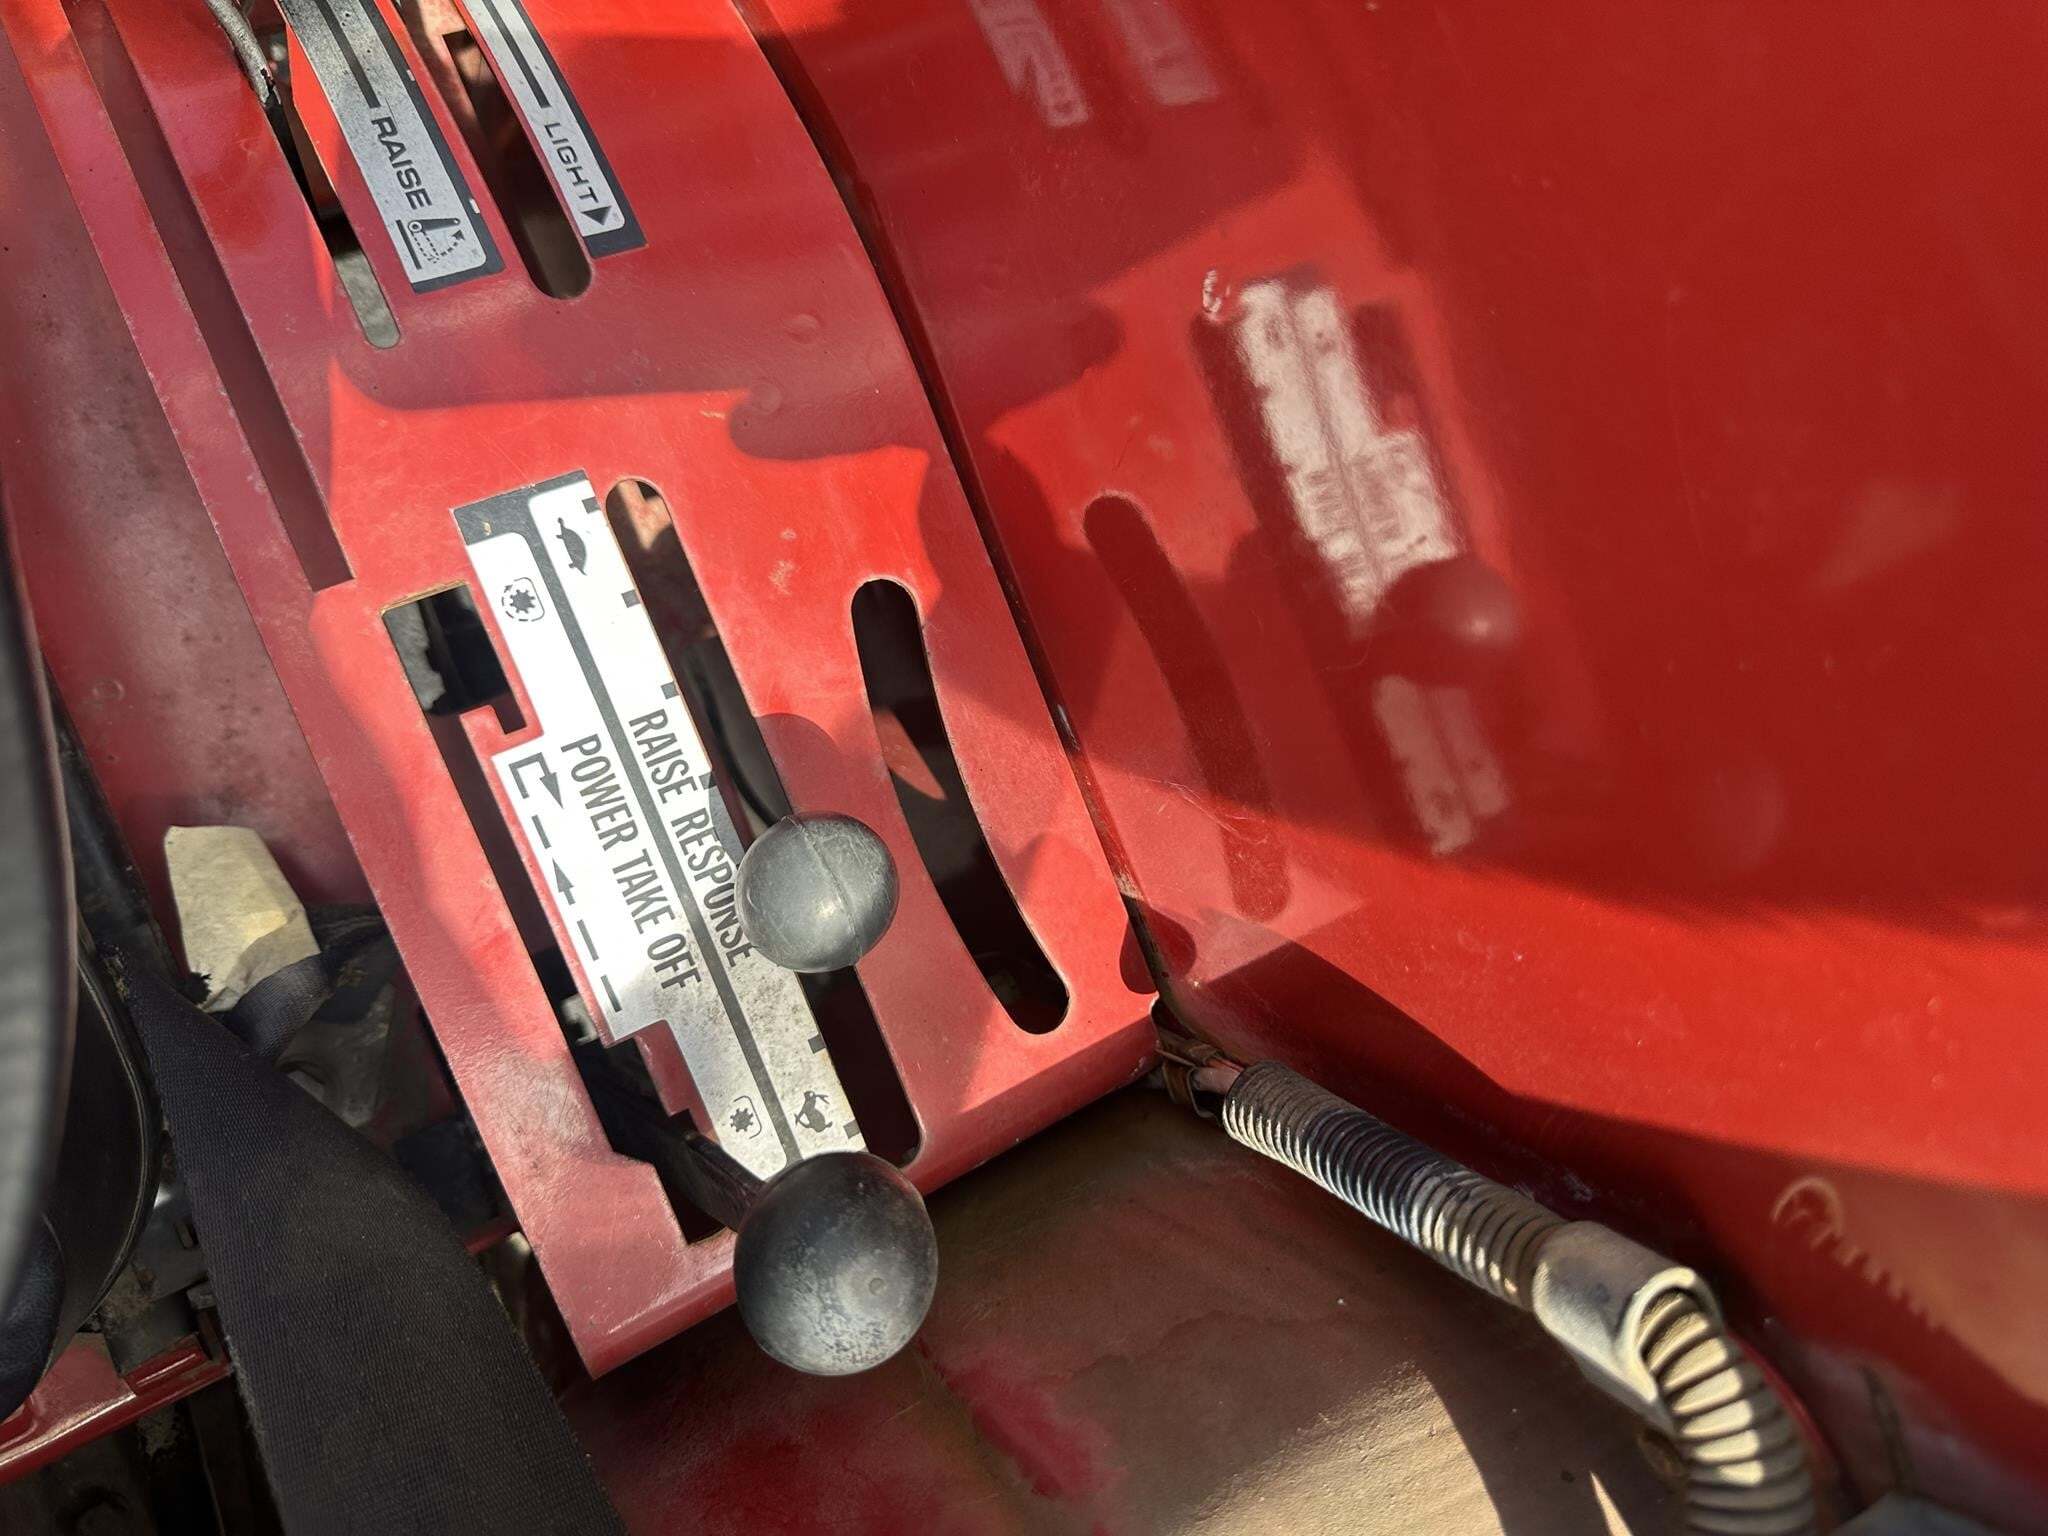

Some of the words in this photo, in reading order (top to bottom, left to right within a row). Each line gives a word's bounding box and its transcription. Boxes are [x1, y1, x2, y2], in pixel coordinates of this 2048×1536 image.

[371, 117, 432, 210] RAISE
[544, 121, 599, 204] LIGHT
[561, 733, 639, 852] POWER
[612, 848, 675, 935] TAKE
[647, 931, 702, 990] OFF
[629, 709, 698, 804] RAISE
[671, 807, 754, 968] RESPONSE
